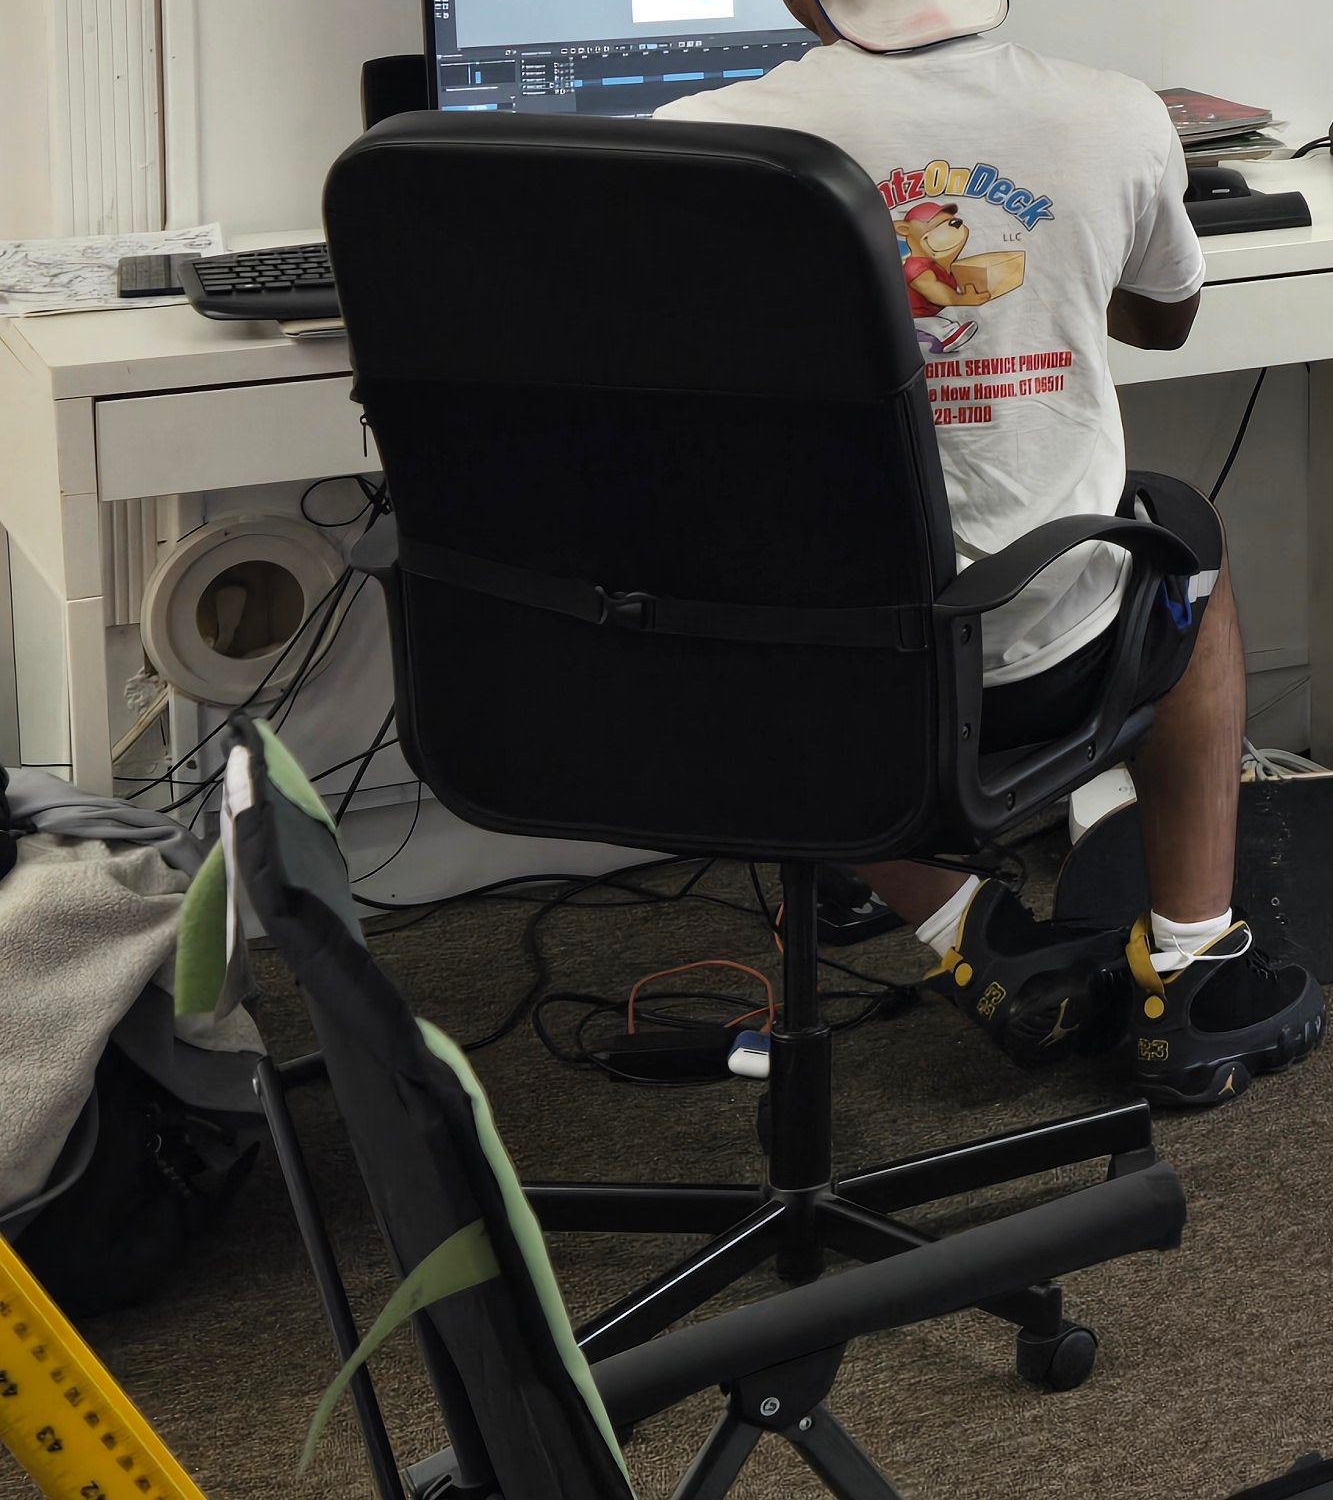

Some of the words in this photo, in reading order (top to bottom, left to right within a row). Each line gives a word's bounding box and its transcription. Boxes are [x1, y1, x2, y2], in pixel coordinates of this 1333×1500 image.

[1003, 233, 1021, 242] LLC
[926, 360, 962, 379] GITAL
[966, 357, 1016, 376] SERVICE
[1019, 351, 1073, 372] PROVIDER
[1019, 378, 1032, 396] CT
